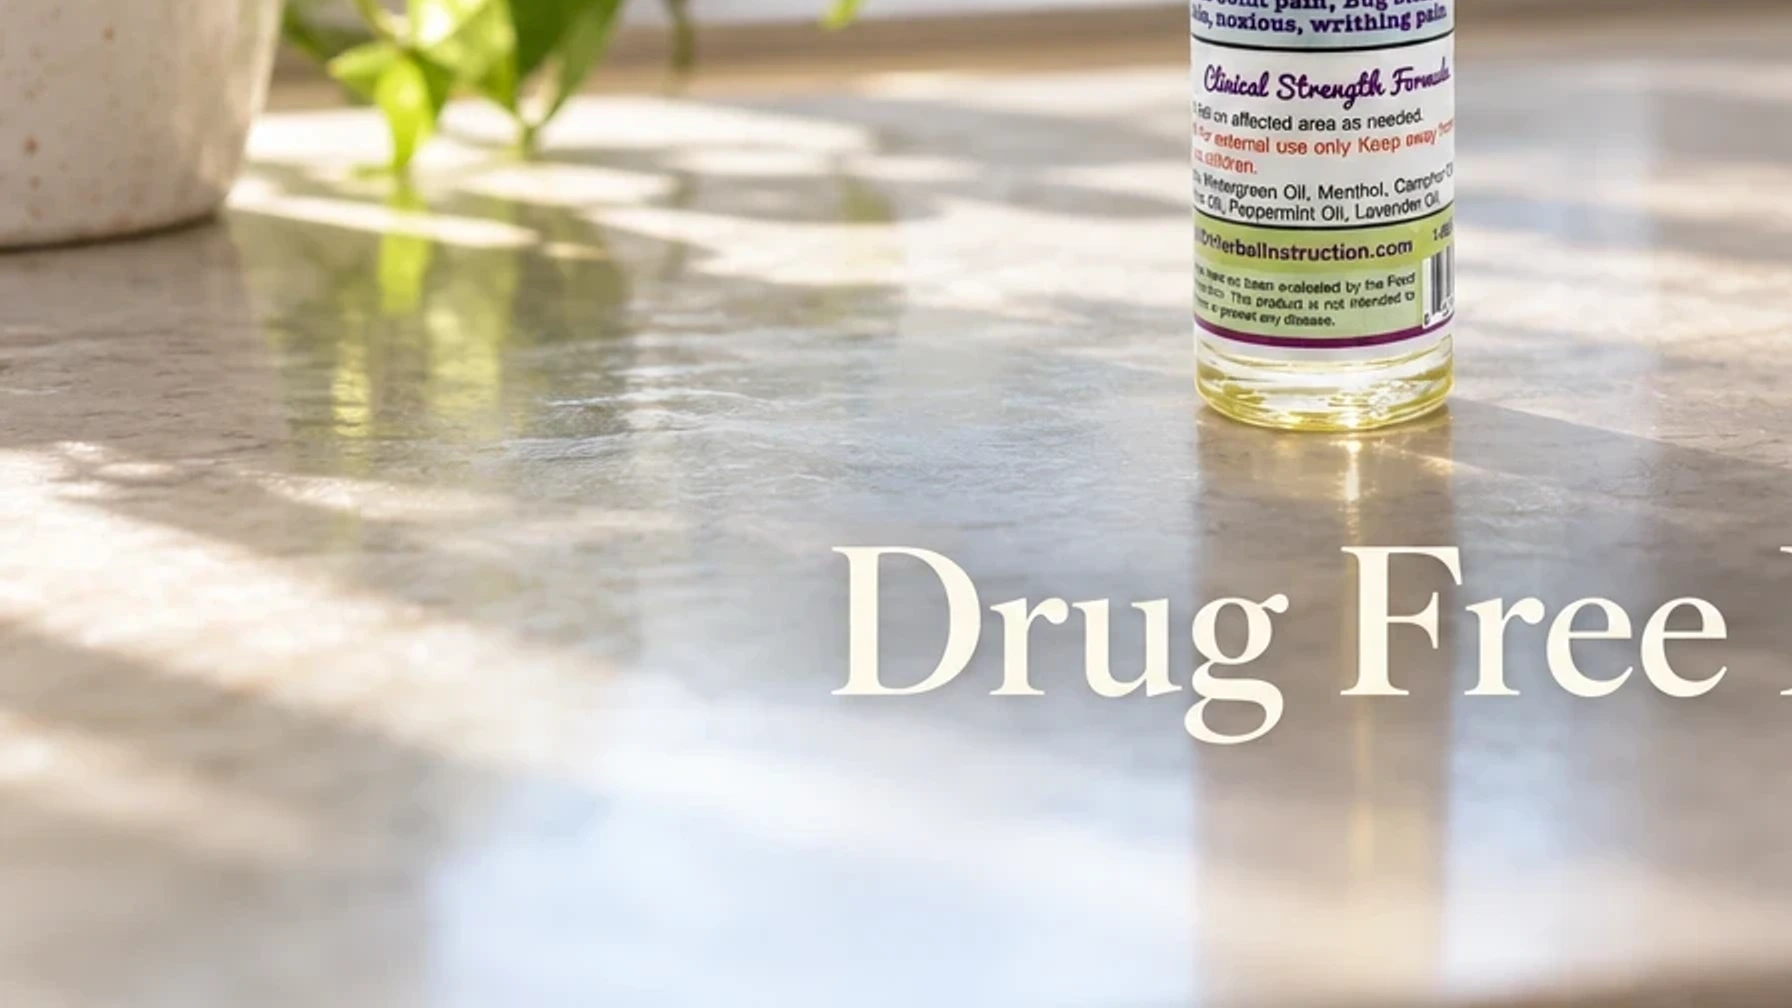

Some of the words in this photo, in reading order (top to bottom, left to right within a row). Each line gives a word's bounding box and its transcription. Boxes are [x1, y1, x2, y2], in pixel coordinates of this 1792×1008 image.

[1216, 12, 1304, 35] noxious,
[1310, 11, 1411, 32] writhing
[1203, 63, 1270, 98] Clinical
[1276, 68, 1386, 110] Strength
[1231, 111, 1292, 131] affected
[1298, 117, 1336, 132] area
[1342, 117, 1361, 131] as
[1276, 141, 1307, 154] use
[1314, 140, 1351, 158] only
[1358, 136, 1401, 154] Keep
[1229, 199, 1316, 221] Peppermint
